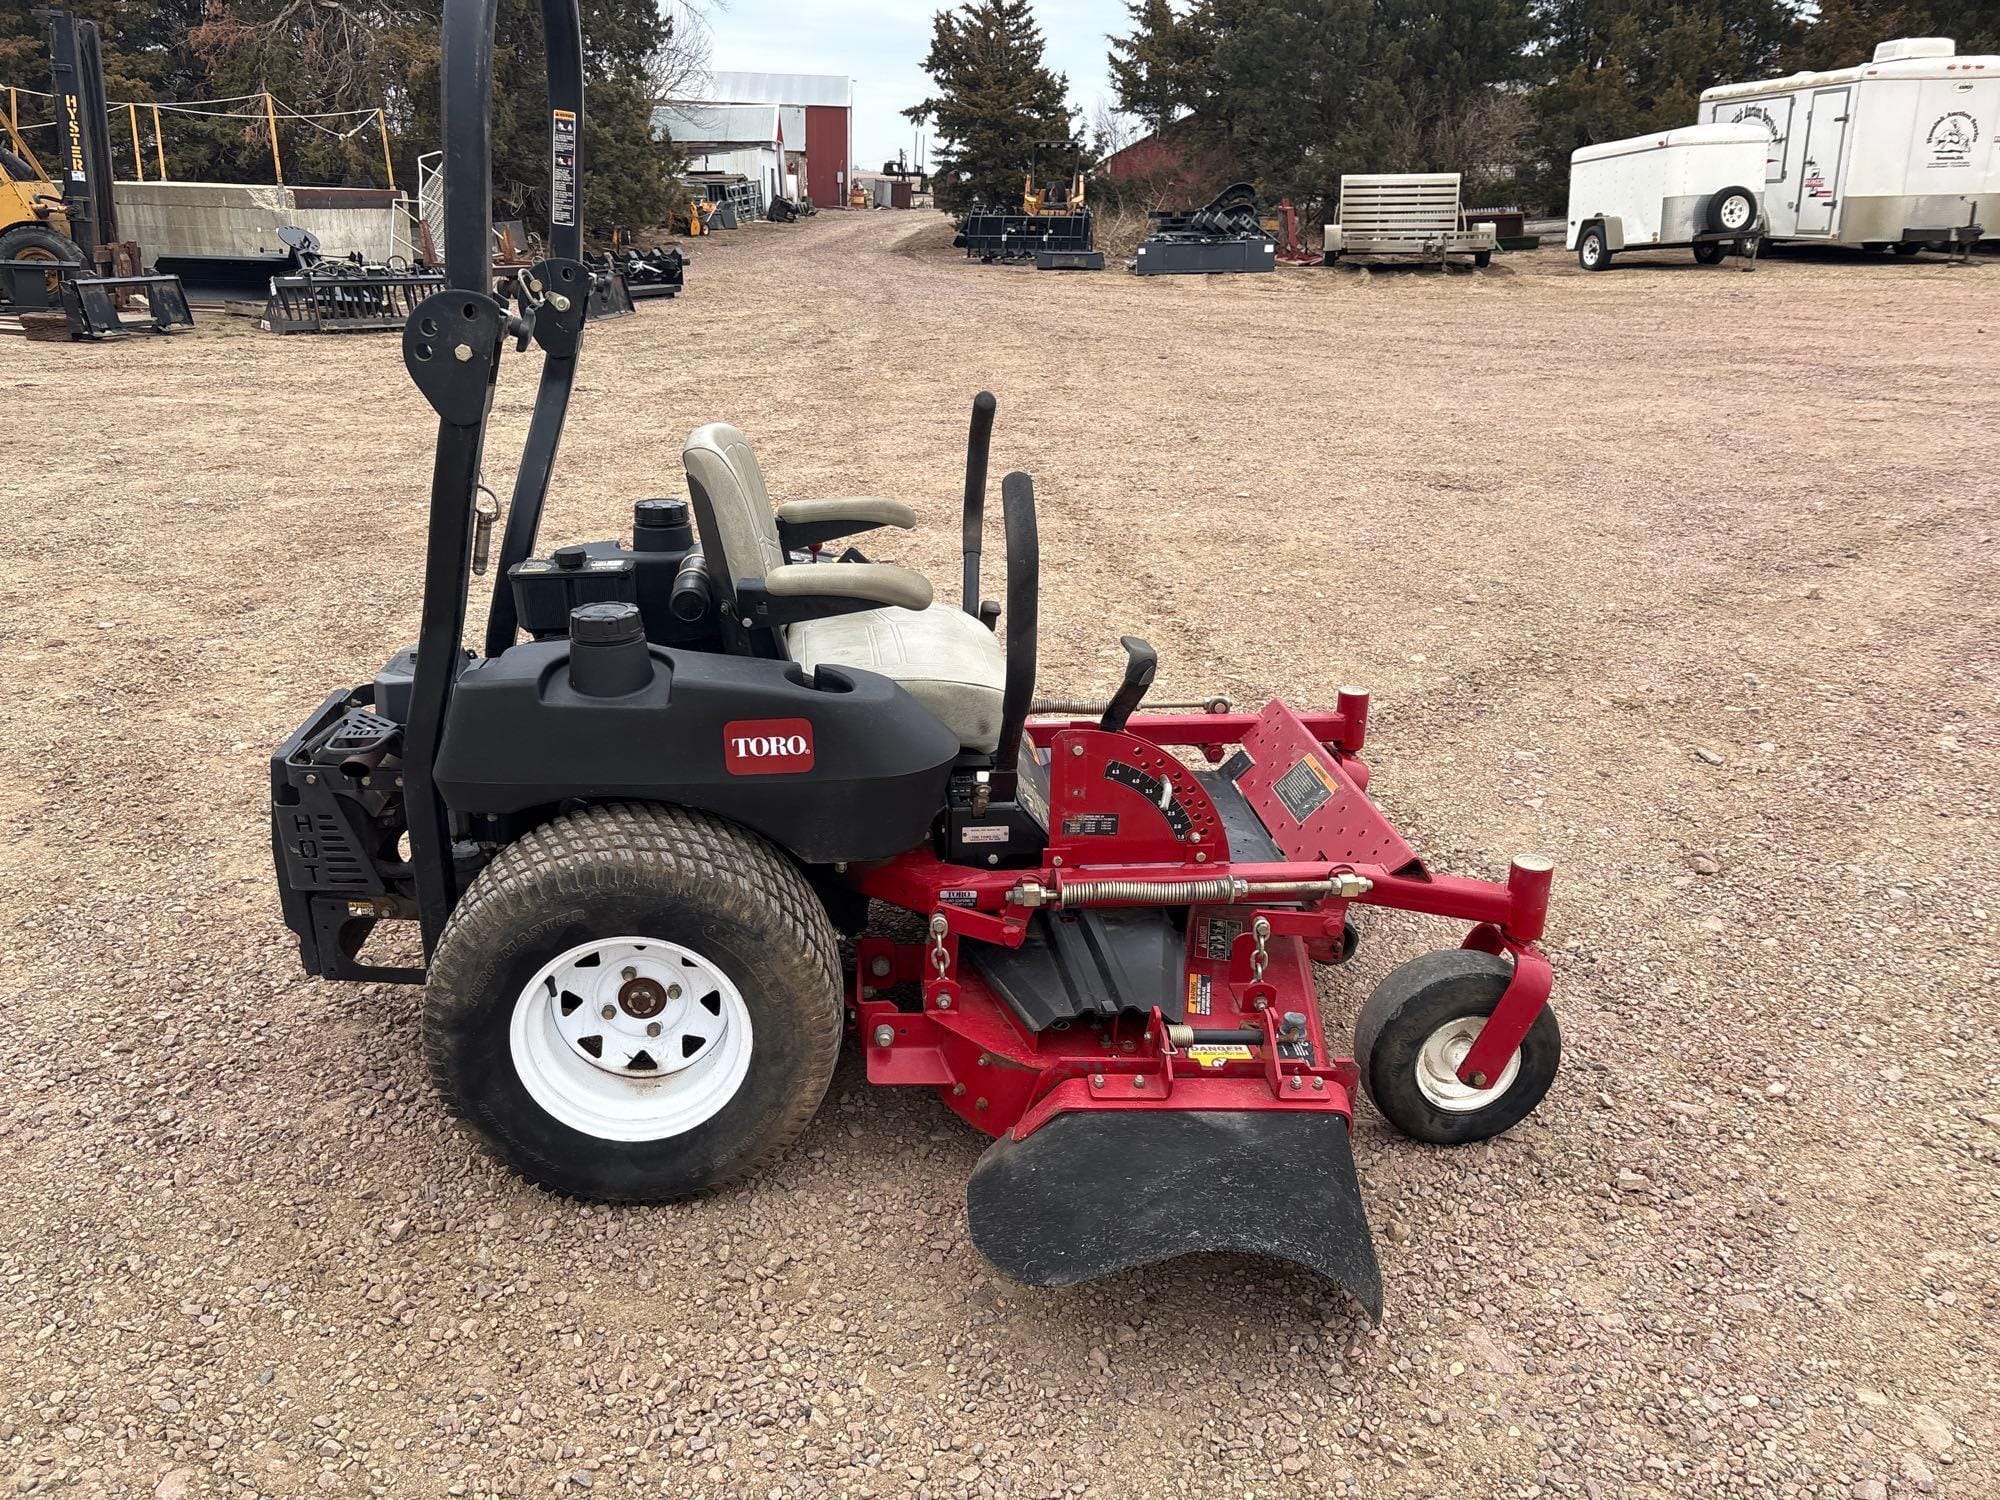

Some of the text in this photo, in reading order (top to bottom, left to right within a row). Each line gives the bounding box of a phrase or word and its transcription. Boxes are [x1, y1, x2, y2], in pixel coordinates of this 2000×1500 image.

[65, 94, 84, 171] HYSTER
[1970, 118, 1979, 142] Service
[346, 729, 384, 737] HOT
[731, 735, 807, 757] TORO
[294, 814, 319, 884] HOT
[501, 909, 586, 959] MASTER
